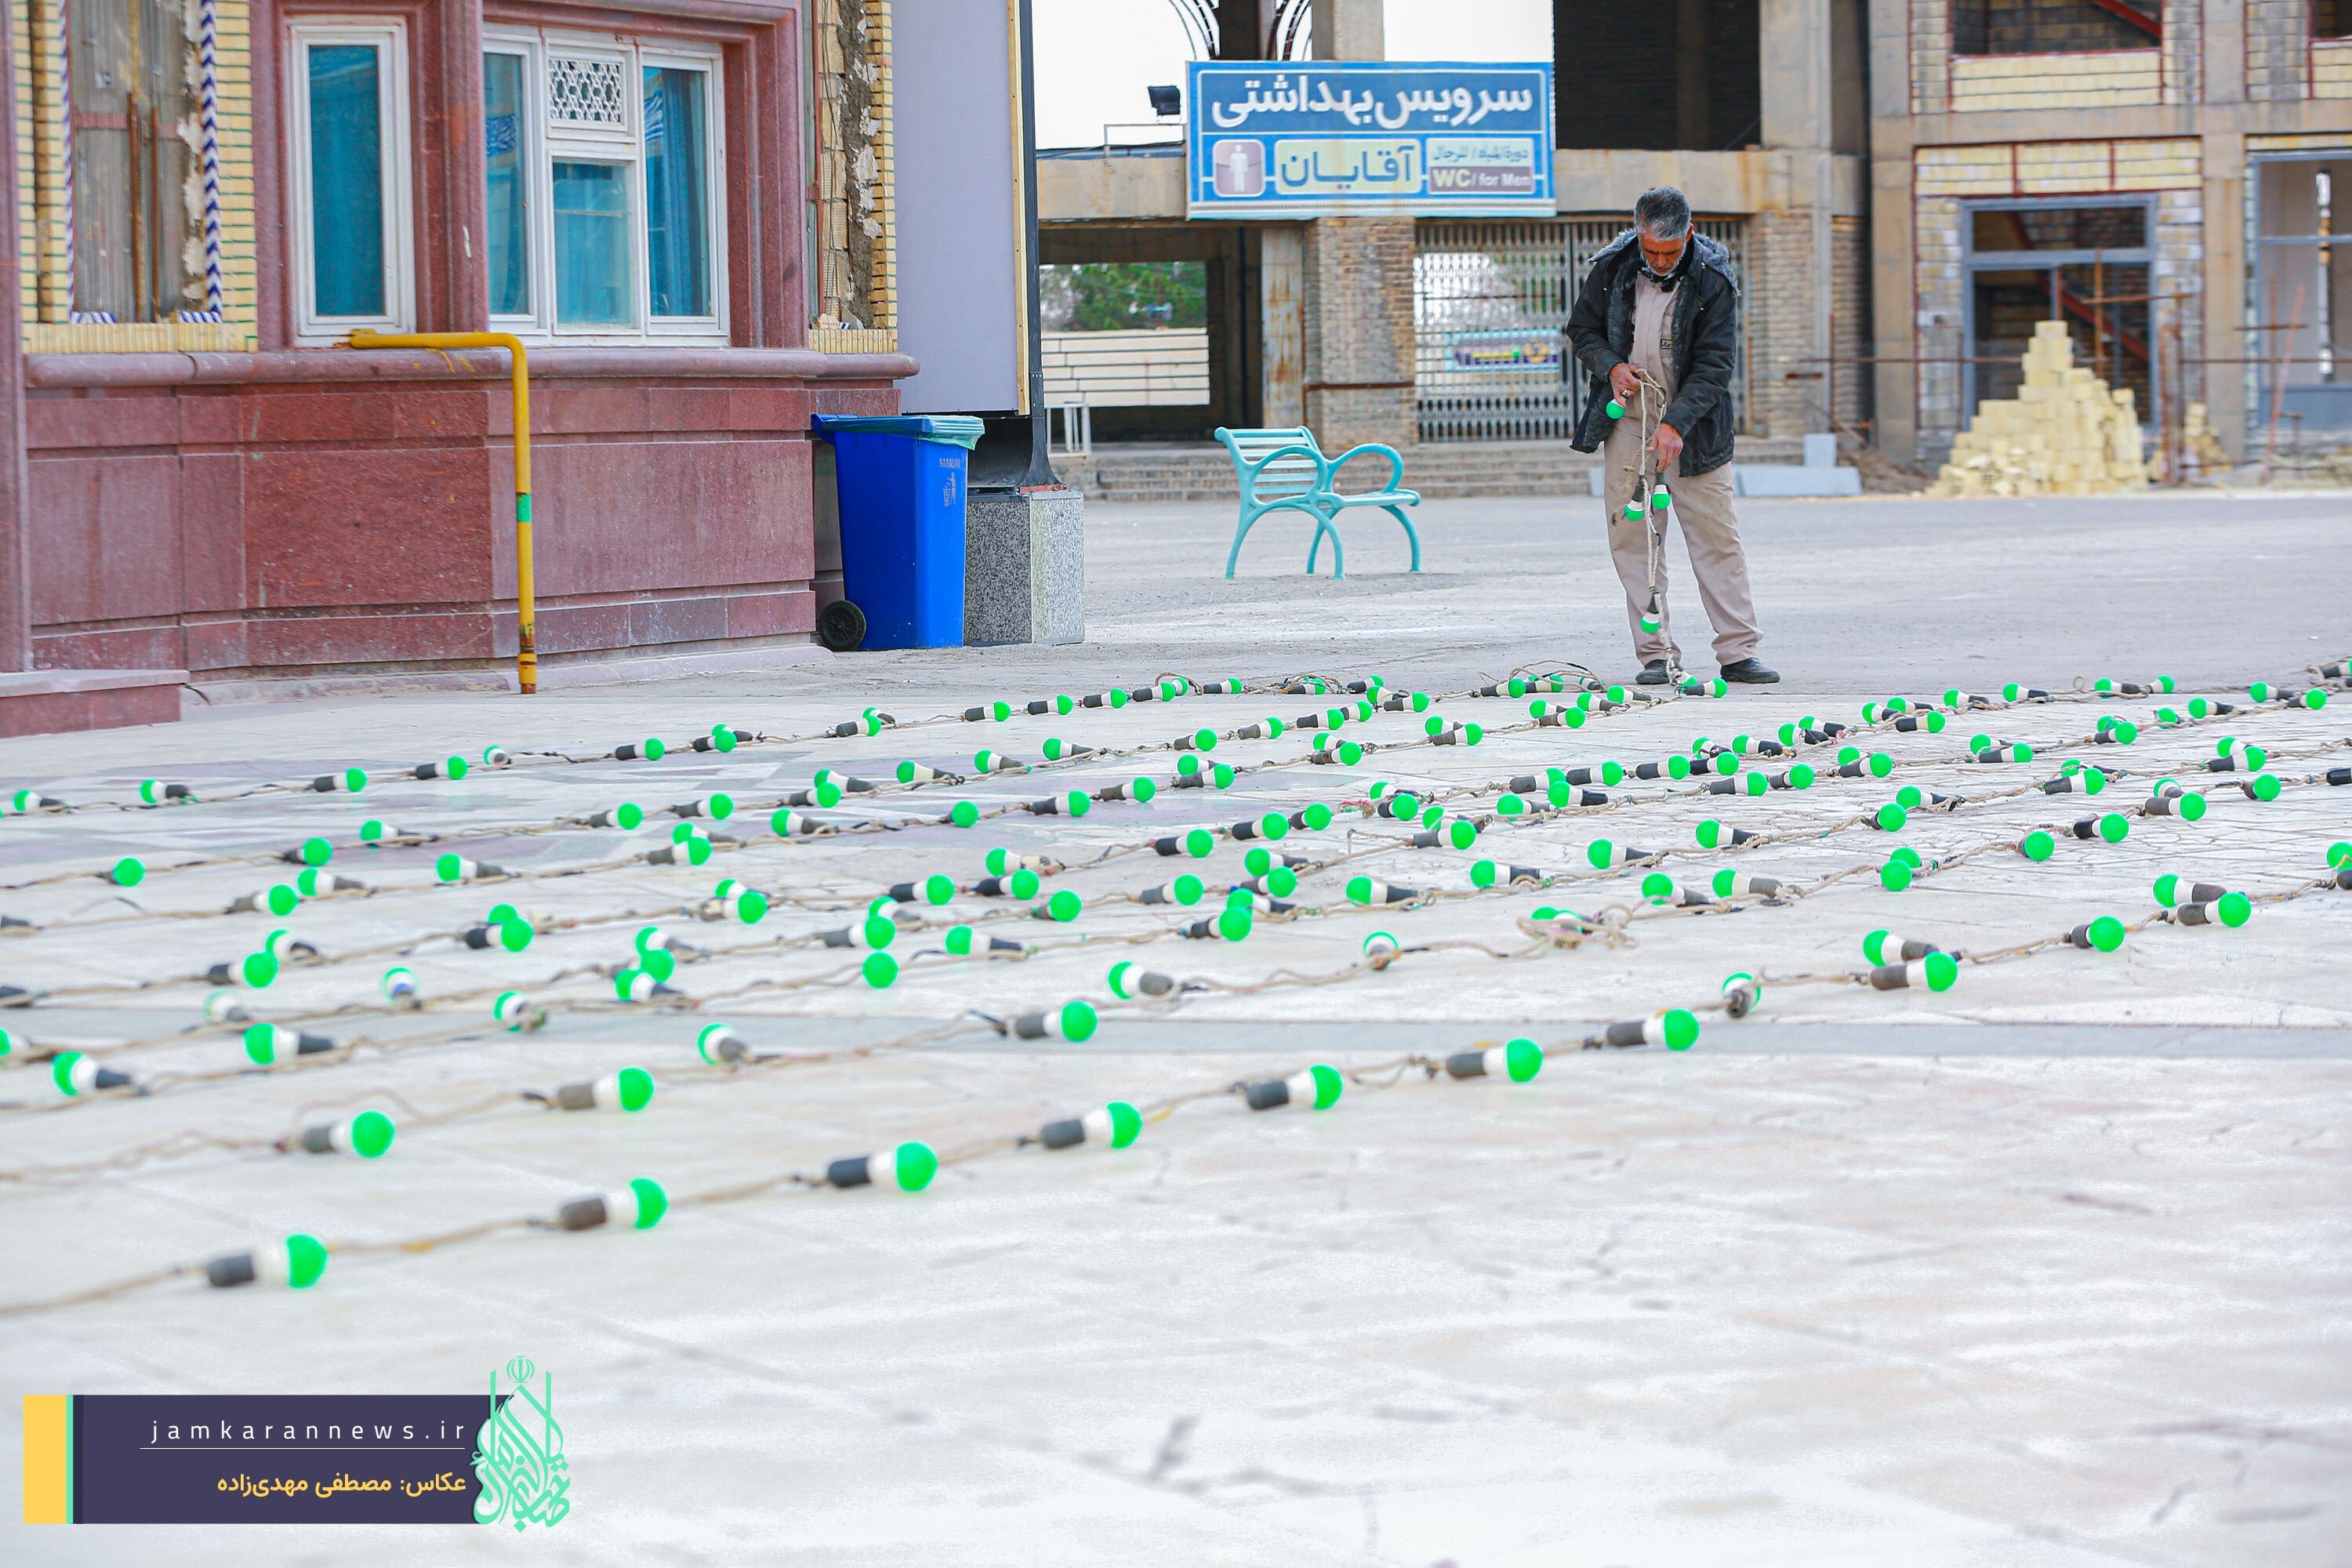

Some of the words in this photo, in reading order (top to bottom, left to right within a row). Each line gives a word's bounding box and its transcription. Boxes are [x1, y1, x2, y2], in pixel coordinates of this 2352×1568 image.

[1211, 74, 1374, 129] بهداشتی
[1374, 86, 1534, 129] سرویس
[1280, 144, 1415, 191] آقایان
[1478, 172, 1500, 187] for
[1501, 173, 1531, 187] Men
